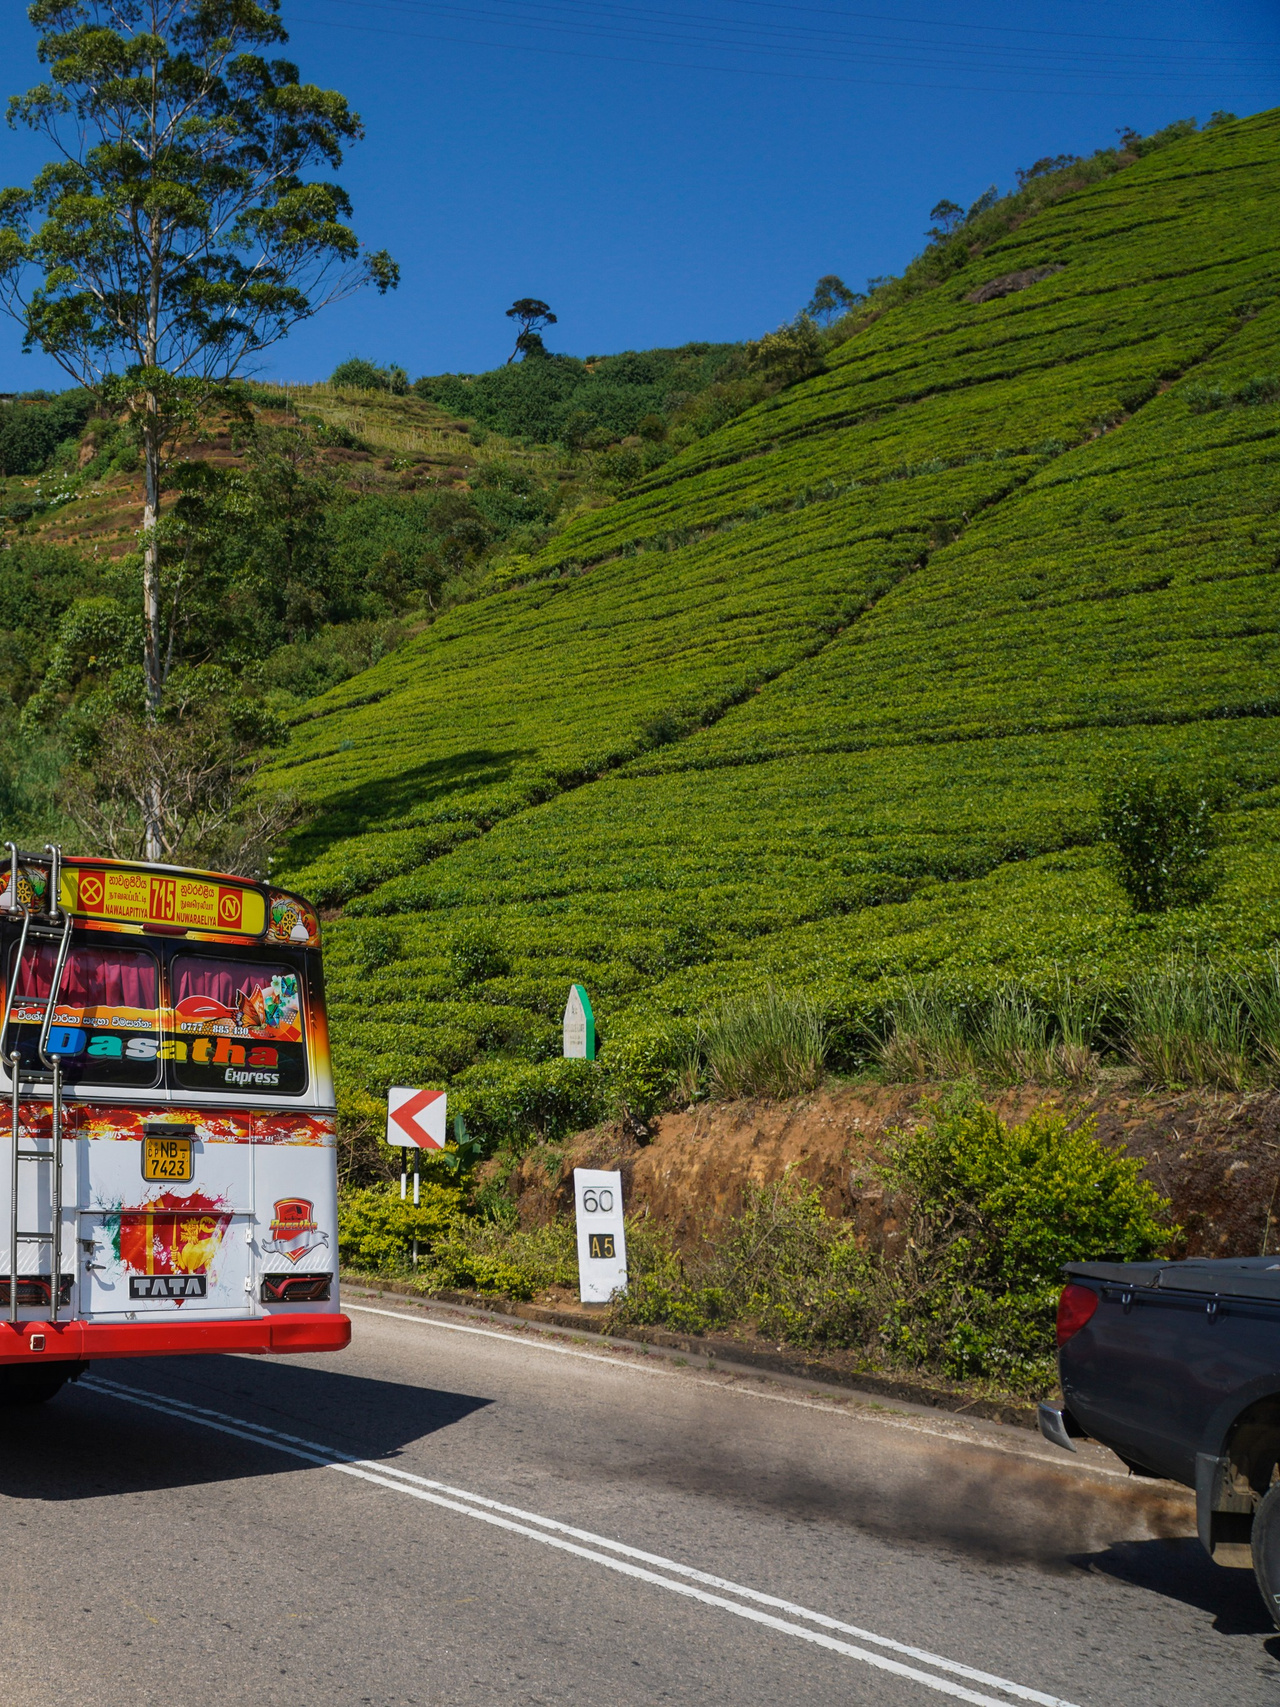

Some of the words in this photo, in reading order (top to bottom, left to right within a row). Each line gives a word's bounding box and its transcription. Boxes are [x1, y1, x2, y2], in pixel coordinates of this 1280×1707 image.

[152, 880, 174, 919] 715
[105, 904, 148, 918] NAWALAPITIYA
[176, 912, 216, 926] NUWARAELIYA
[180, 1022, 203, 1032] 0777
[212, 1024, 230, 1034] 885
[46, 1026, 279, 1069] Dasatha
[224, 1067, 280, 1087] Express
[104, 1131, 122, 1139] AVIS
[151, 1160, 185, 1176] 7423
[583, 1189, 613, 1213] 60
[269, 1219, 318, 1230] Dasatha
[133, 1278, 202, 1296] TATA
